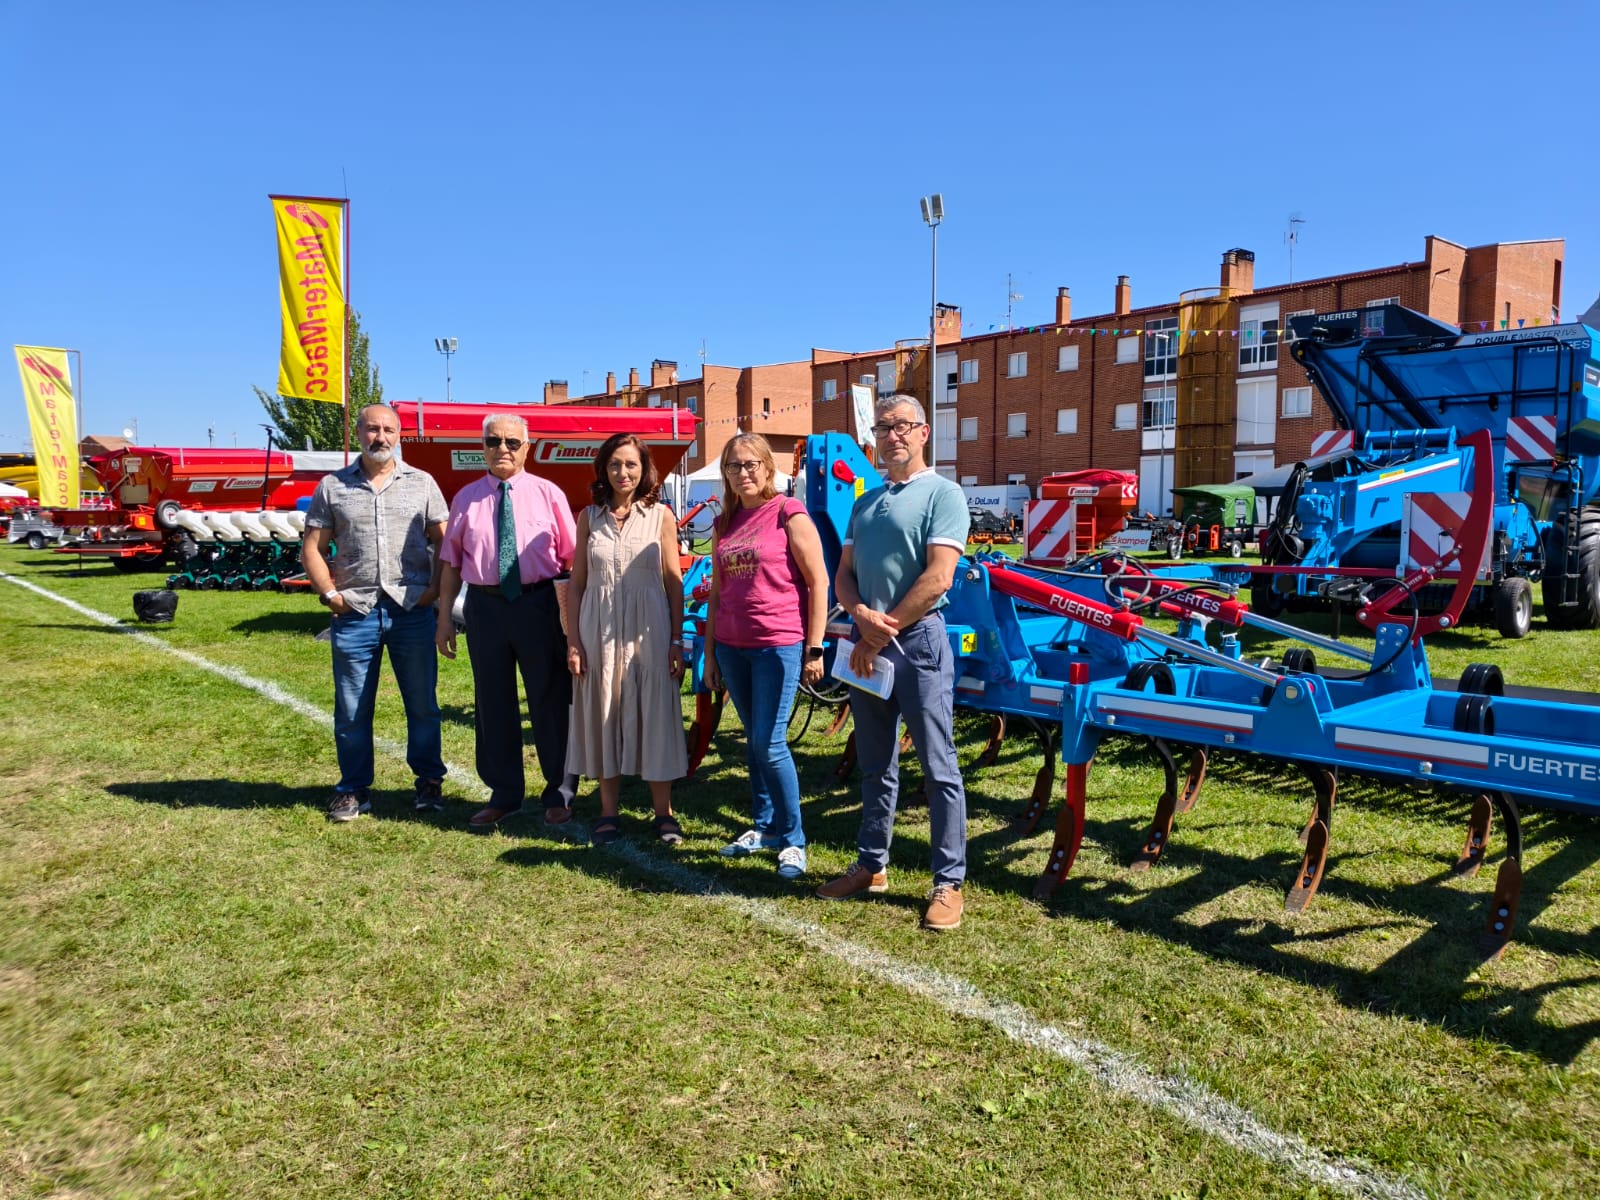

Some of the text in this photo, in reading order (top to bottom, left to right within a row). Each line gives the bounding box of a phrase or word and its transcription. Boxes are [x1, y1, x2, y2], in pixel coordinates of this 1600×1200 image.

[1318, 311, 1358, 323] FUERTES
[974, 497, 1000, 505] DeLaval
[1049, 593, 1113, 627] FUERTES
[1494, 751, 1600, 782] FUERTE
